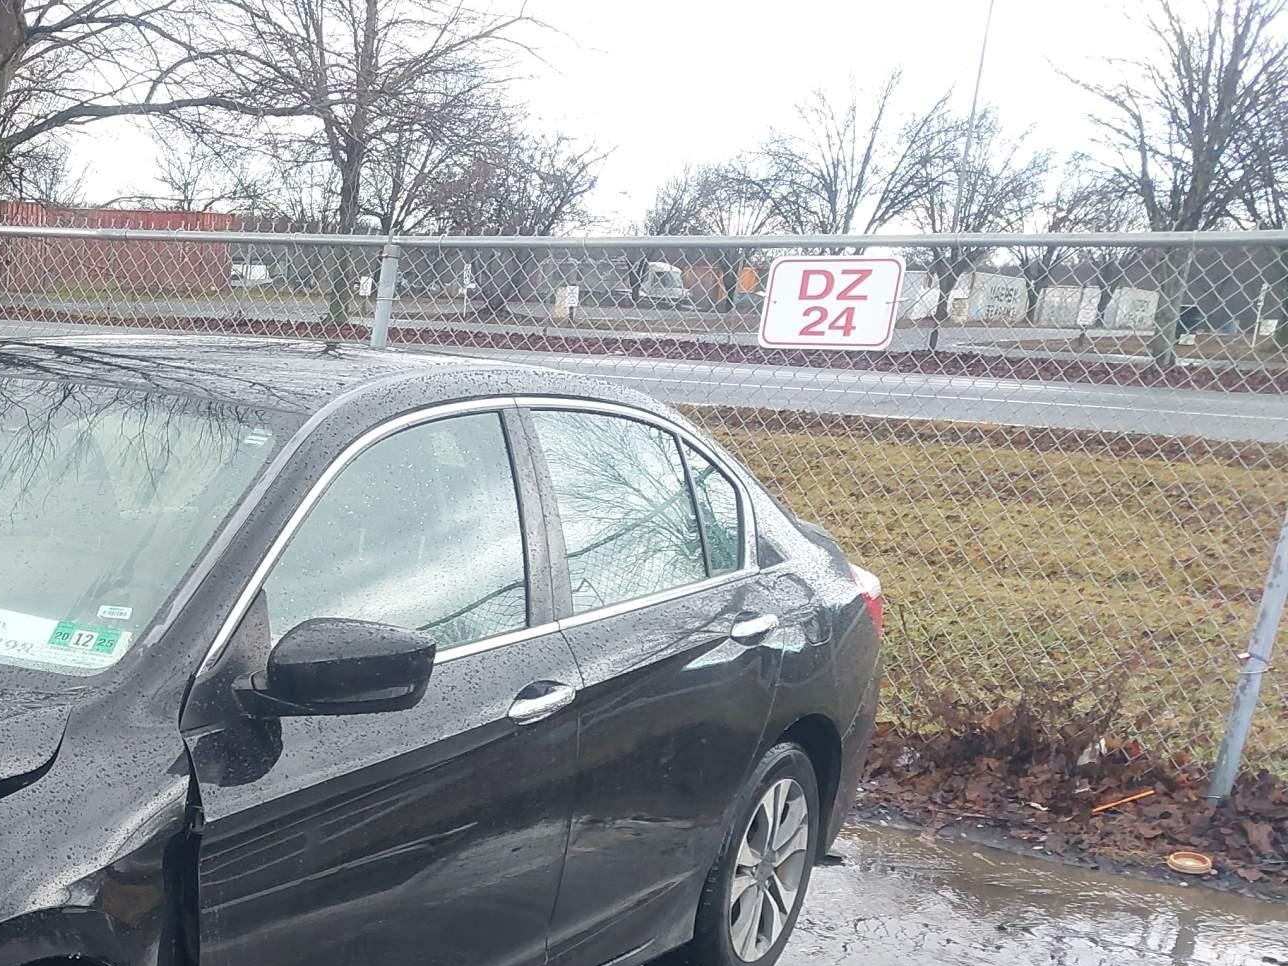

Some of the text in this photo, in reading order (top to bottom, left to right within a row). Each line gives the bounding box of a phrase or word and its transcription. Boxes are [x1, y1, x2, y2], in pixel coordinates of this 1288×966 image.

[798, 269, 873, 301] DZ
[798, 306, 856, 337] 24
[54, 631, 114, 648] 20 12 25
